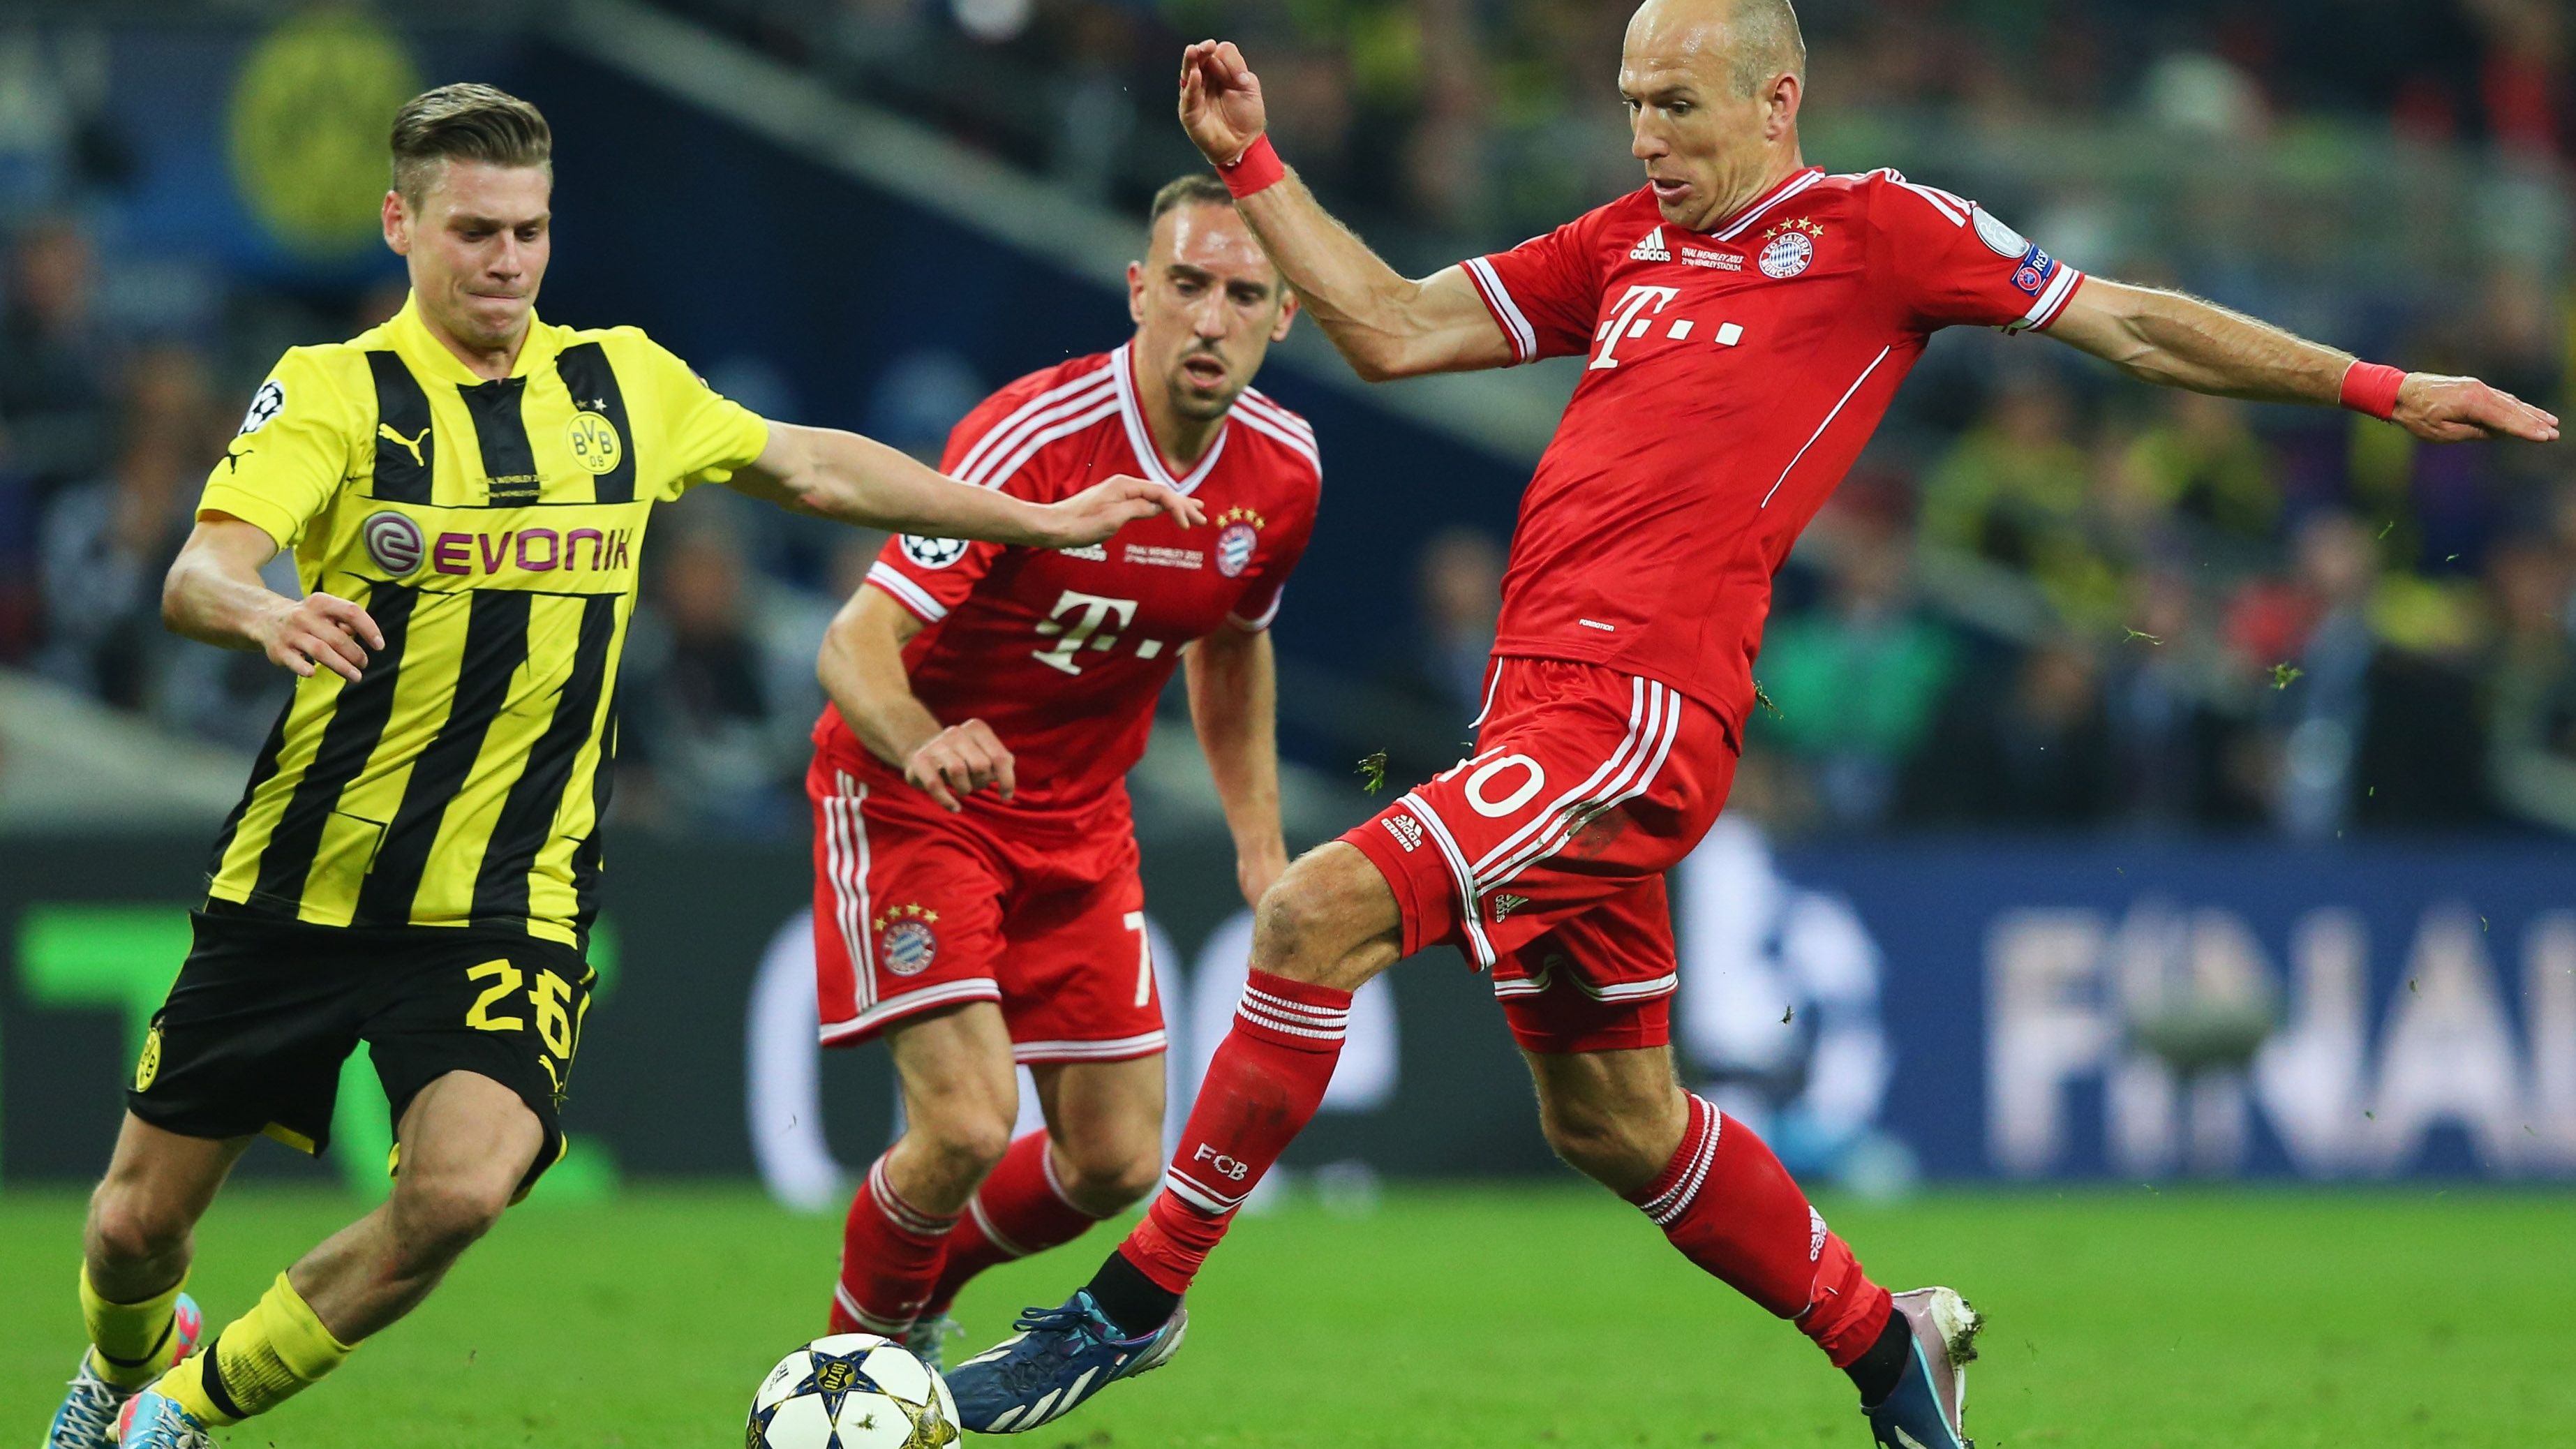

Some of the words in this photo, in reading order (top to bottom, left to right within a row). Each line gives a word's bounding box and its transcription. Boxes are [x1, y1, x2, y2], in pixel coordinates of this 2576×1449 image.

[1630, 248, 1672, 262] adidas
[1681, 247, 1697, 258] FINAL
[1697, 250, 1729, 262] WEMBLEY
[1779, 235, 1810, 255] BAYERN
[1716, 261, 1742, 272] STADIUM
[573, 420, 613, 455] BVB
[590, 455, 604, 467] 09
[433, 528, 633, 575] EVONIK
[1123, 910, 1151, 1007] 7
[466, 958, 572, 1059] 26
[1193, 1142, 1248, 1180] FCB
